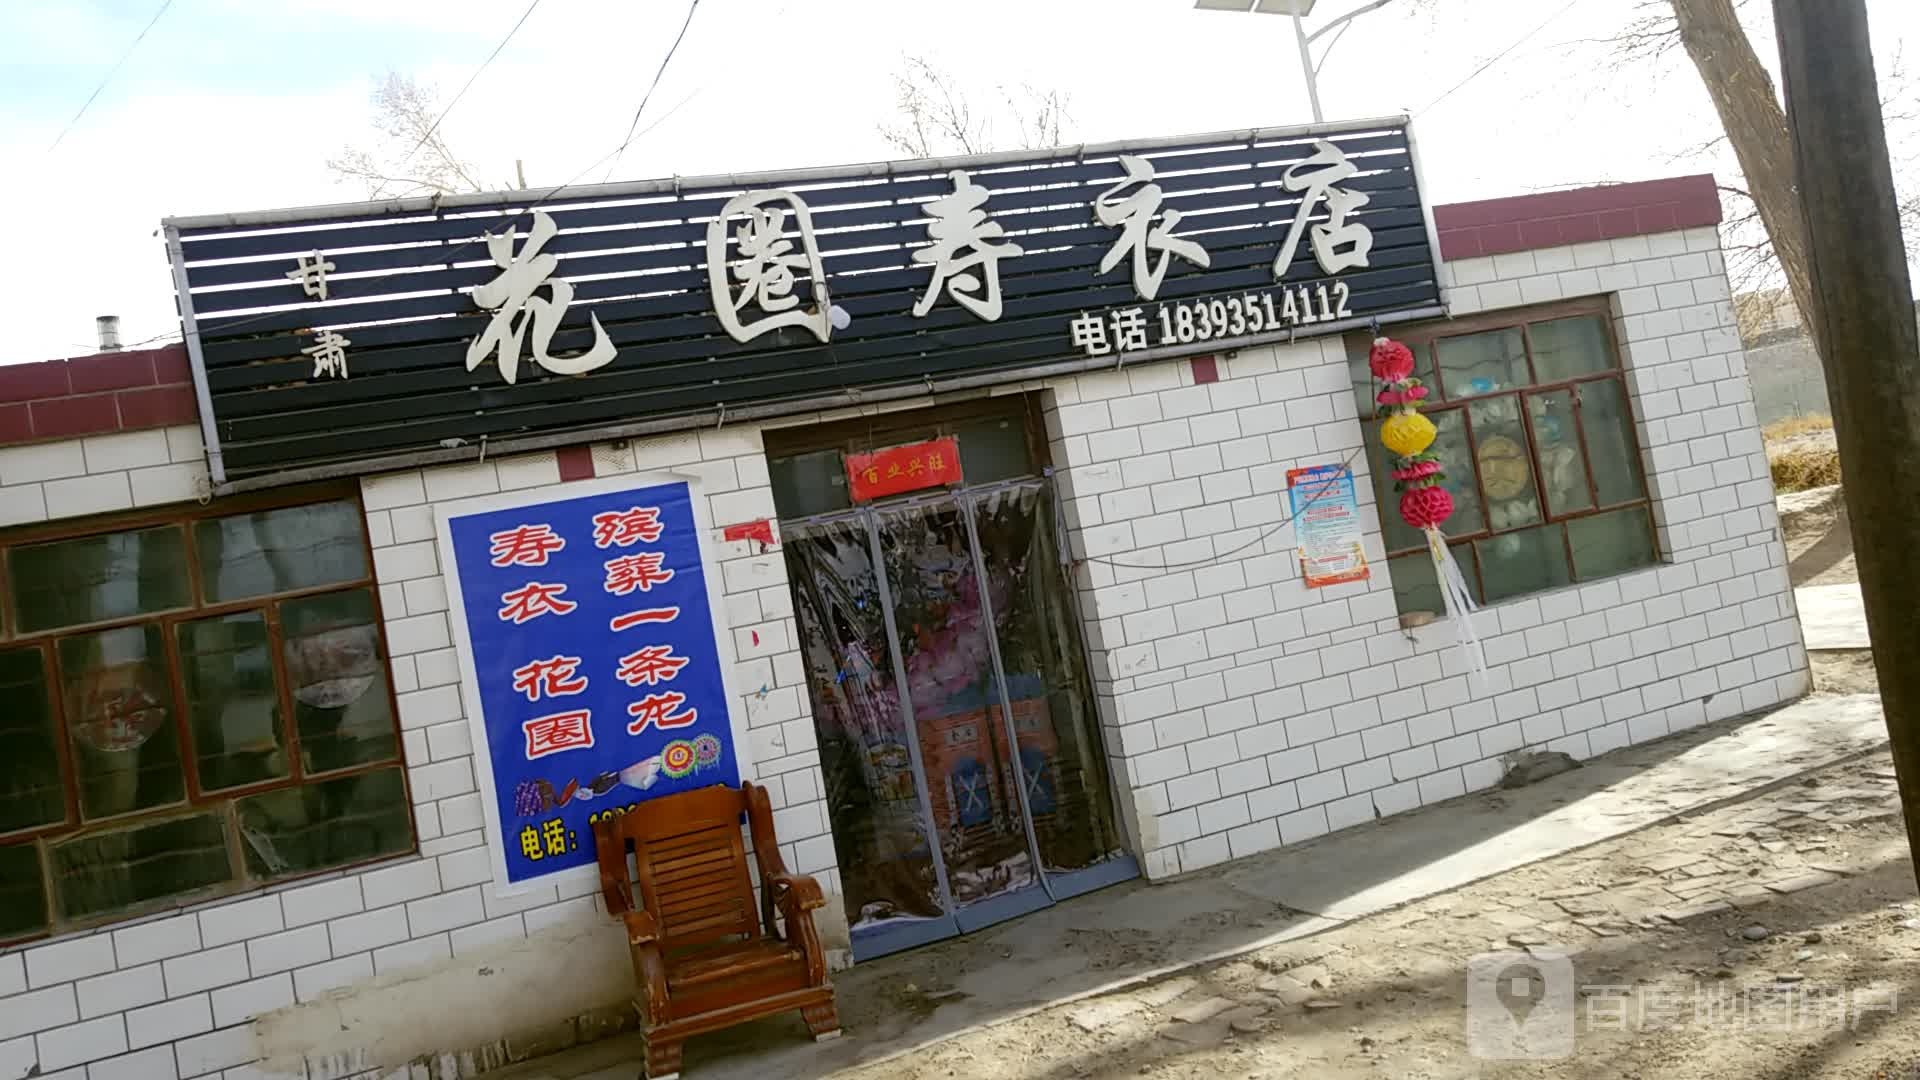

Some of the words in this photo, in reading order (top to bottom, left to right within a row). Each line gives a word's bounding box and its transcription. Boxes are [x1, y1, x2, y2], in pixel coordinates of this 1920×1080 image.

[285, 248, 351, 380] 甘肃
[465, 140, 1373, 384] 花圈寿衣店
[1070, 307, 1149, 355] 电话
[1158, 281, 1353, 345] 18393514112
[862, 453, 945, 484] 百业兴旺
[489, 523, 577, 624] 寿衣
[593, 506, 696, 735] 殡葬一条龙
[512, 655, 595, 760] 花圈
